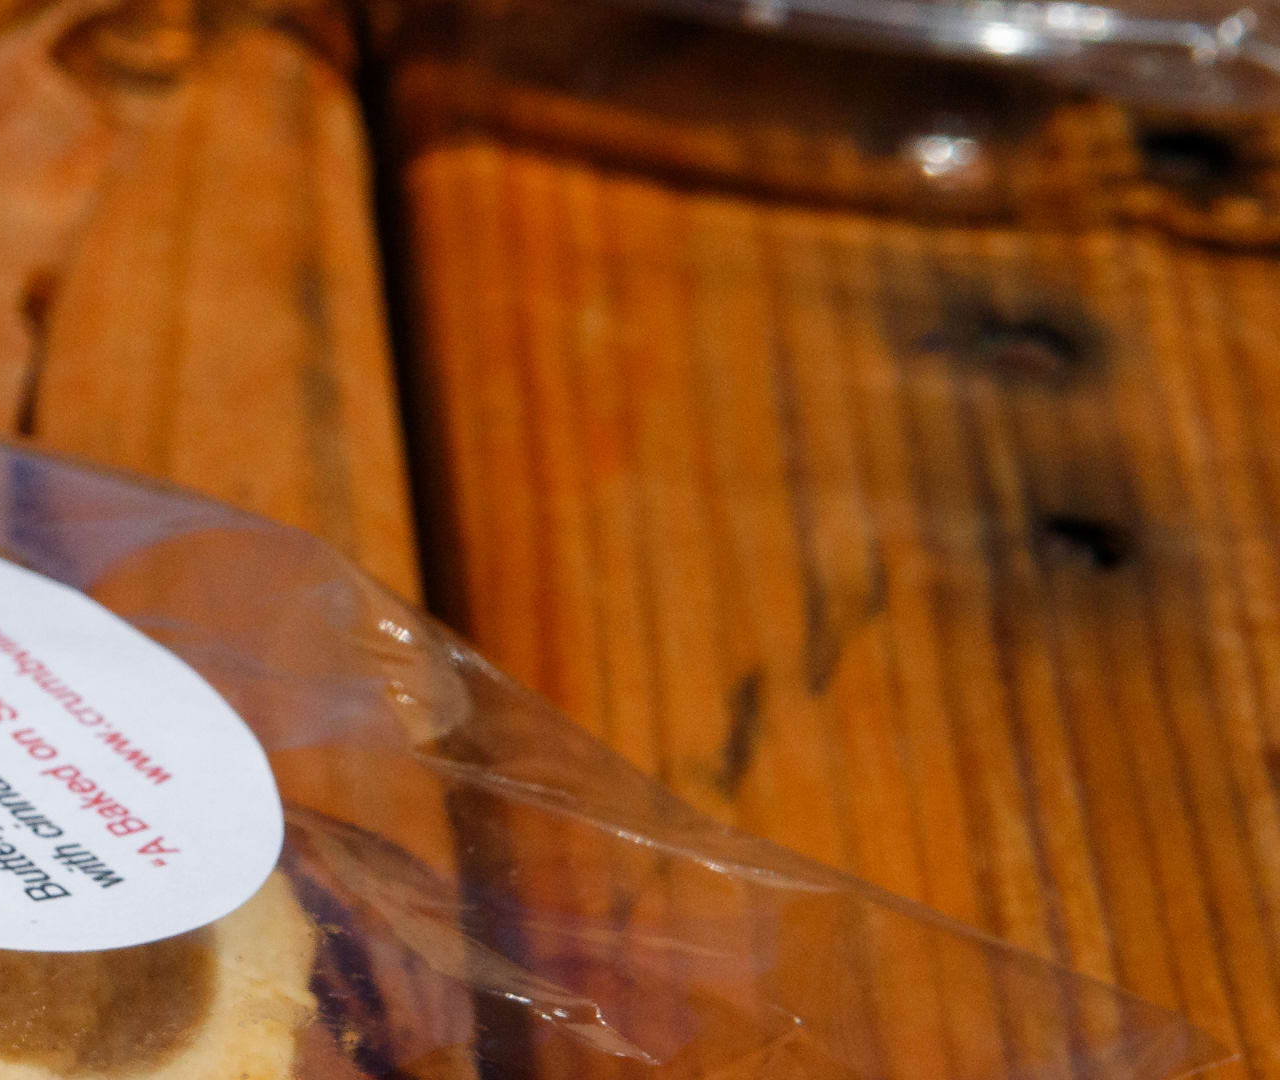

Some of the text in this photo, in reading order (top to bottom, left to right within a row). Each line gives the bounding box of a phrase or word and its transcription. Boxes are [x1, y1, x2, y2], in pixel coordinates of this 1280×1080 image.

[9, 727, 60, 763] on
[39, 763, 152, 838] Baked
[50, 842, 127, 889] with
